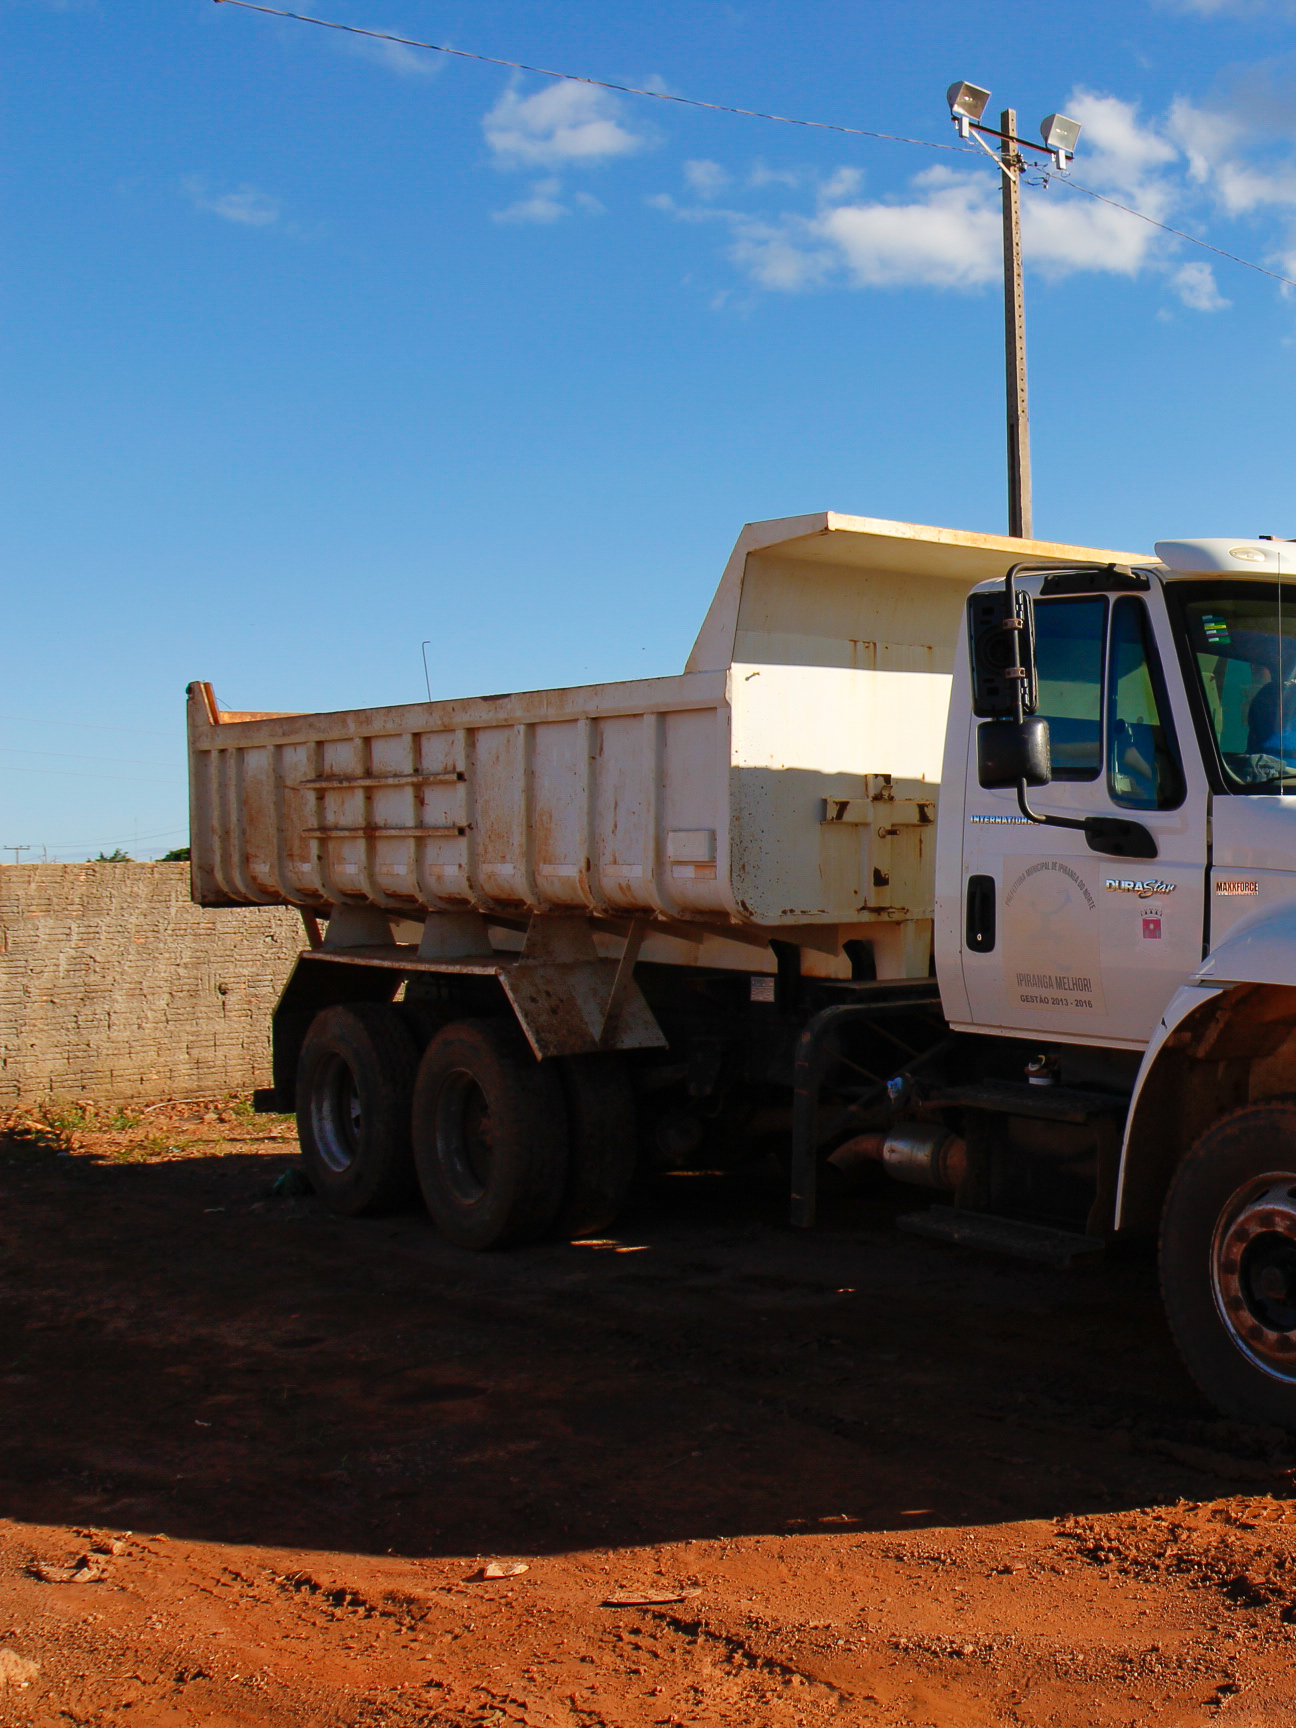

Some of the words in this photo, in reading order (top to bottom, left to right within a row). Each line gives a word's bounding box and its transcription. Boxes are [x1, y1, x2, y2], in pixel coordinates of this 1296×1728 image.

[1004, 872, 1027, 907] PREFEITURA
[1025, 861, 1051, 878] MUNICIPAL
[1051, 861, 1058, 871] DE
[1058, 863, 1081, 884] IPIRANGA
[1077, 879, 1087, 891] DO
[1082, 887, 1097, 911] NORTE
[1216, 882, 1259, 892] MAXXFORCE
[1016, 972, 1054, 990] IPIRANGA
[1055, 976, 1092, 993] MELHOR!
[1020, 994, 1049, 1004] GESTÃO
[1051, 997, 1069, 1006] 2013
[1075, 999, 1093, 1008] 2016
